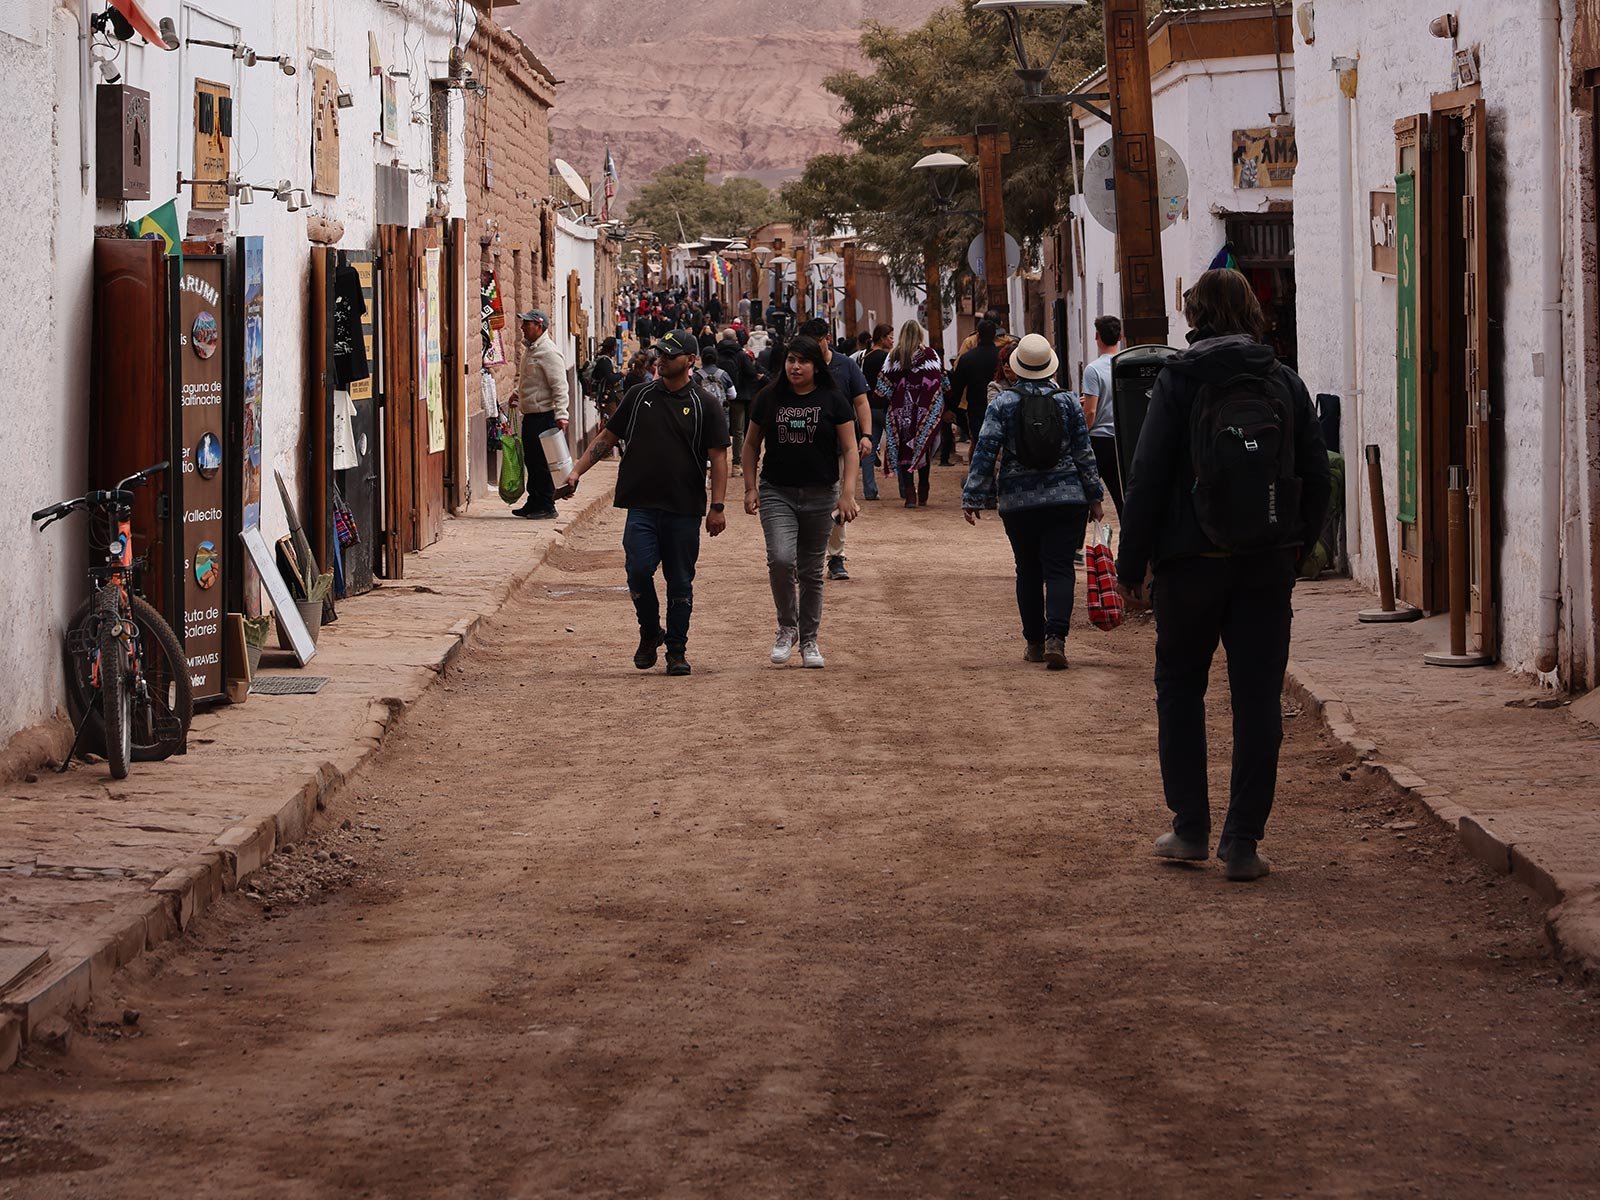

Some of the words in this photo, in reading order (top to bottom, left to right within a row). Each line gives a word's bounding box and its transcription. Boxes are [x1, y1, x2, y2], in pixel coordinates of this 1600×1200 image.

[1402, 233, 1411, 504] SALE
[181, 382, 209, 394] aguna
[210, 381, 222, 392] de
[789, 419, 806, 429] YOUR
[1268, 481, 1278, 524] THULE
[205, 606, 219, 620] de
